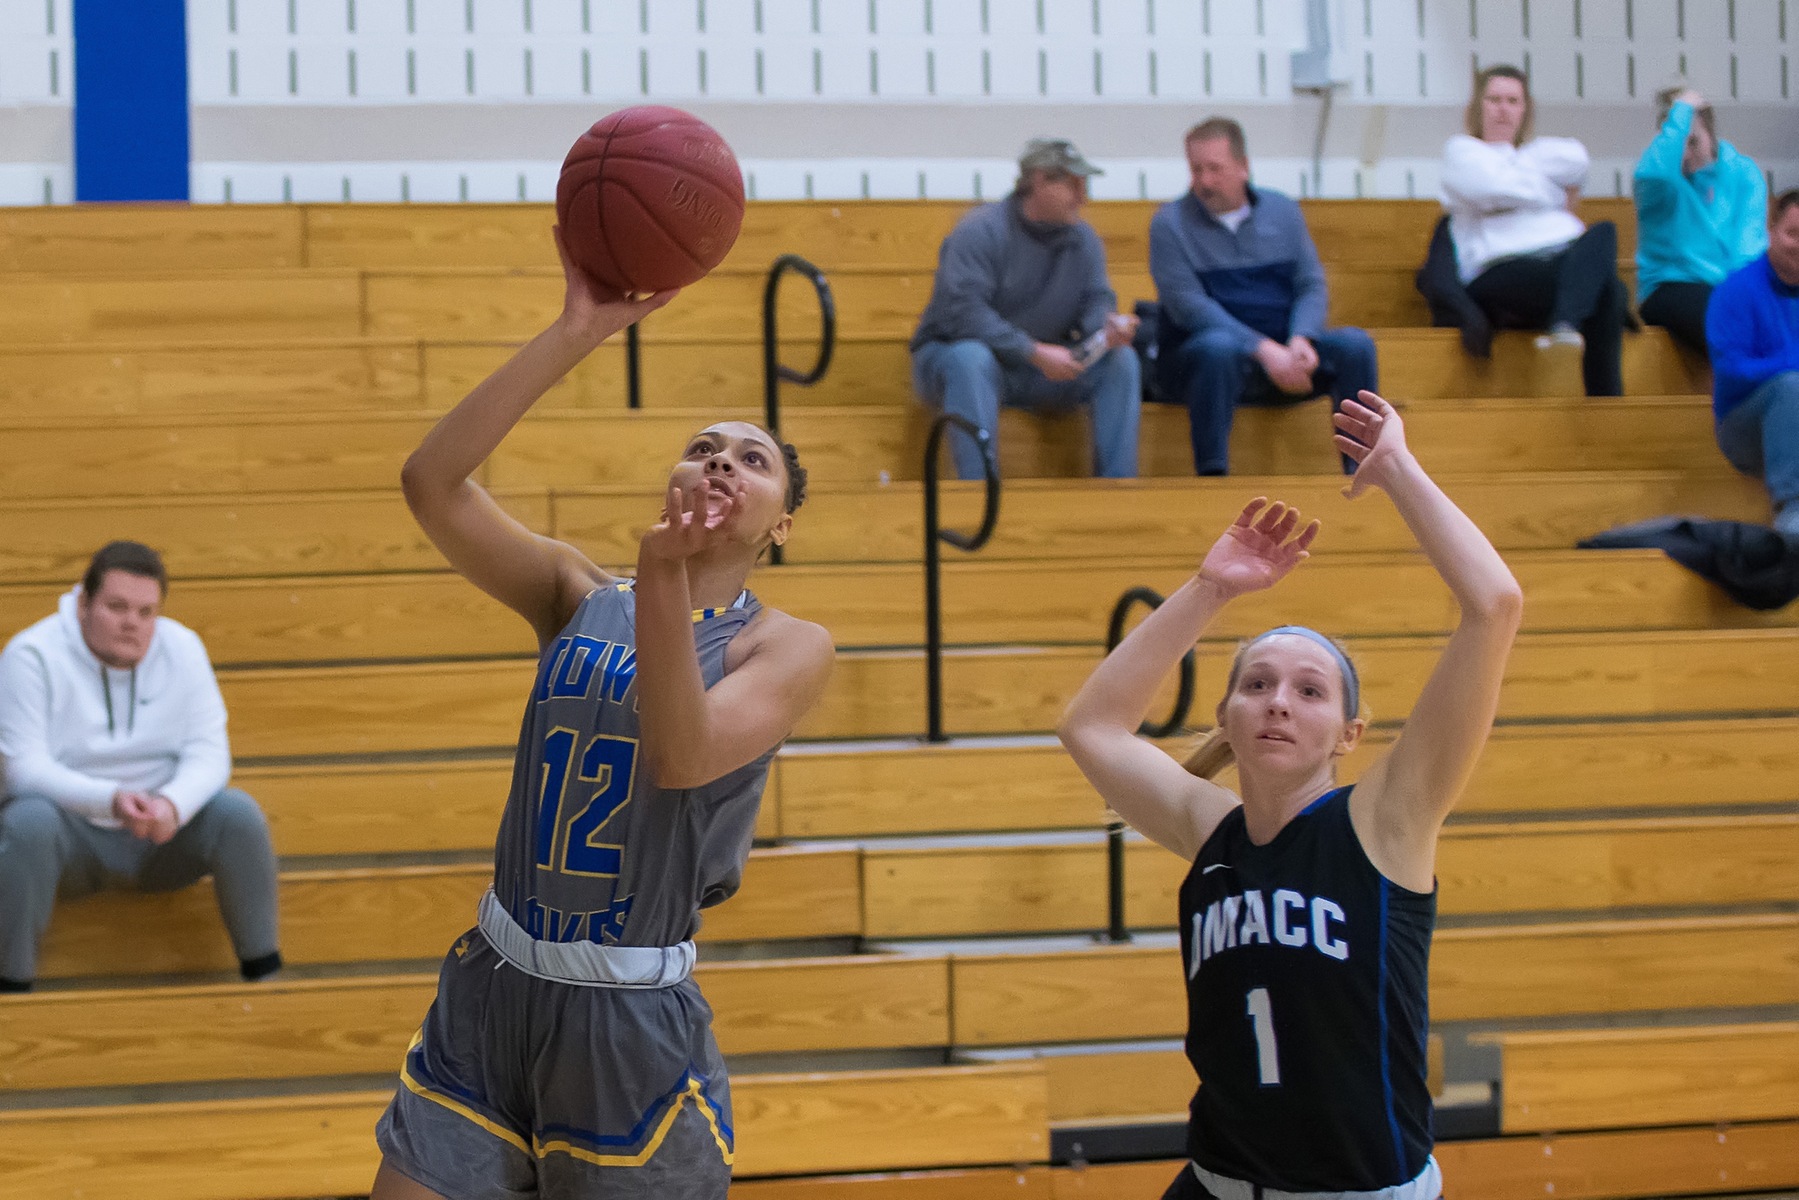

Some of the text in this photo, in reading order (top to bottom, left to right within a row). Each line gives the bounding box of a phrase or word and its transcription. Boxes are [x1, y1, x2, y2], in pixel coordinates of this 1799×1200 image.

[537, 633, 640, 713] IOW
[537, 725, 640, 879] 12
[514, 890, 635, 946] AKES
[1247, 988, 1281, 1084] 1
